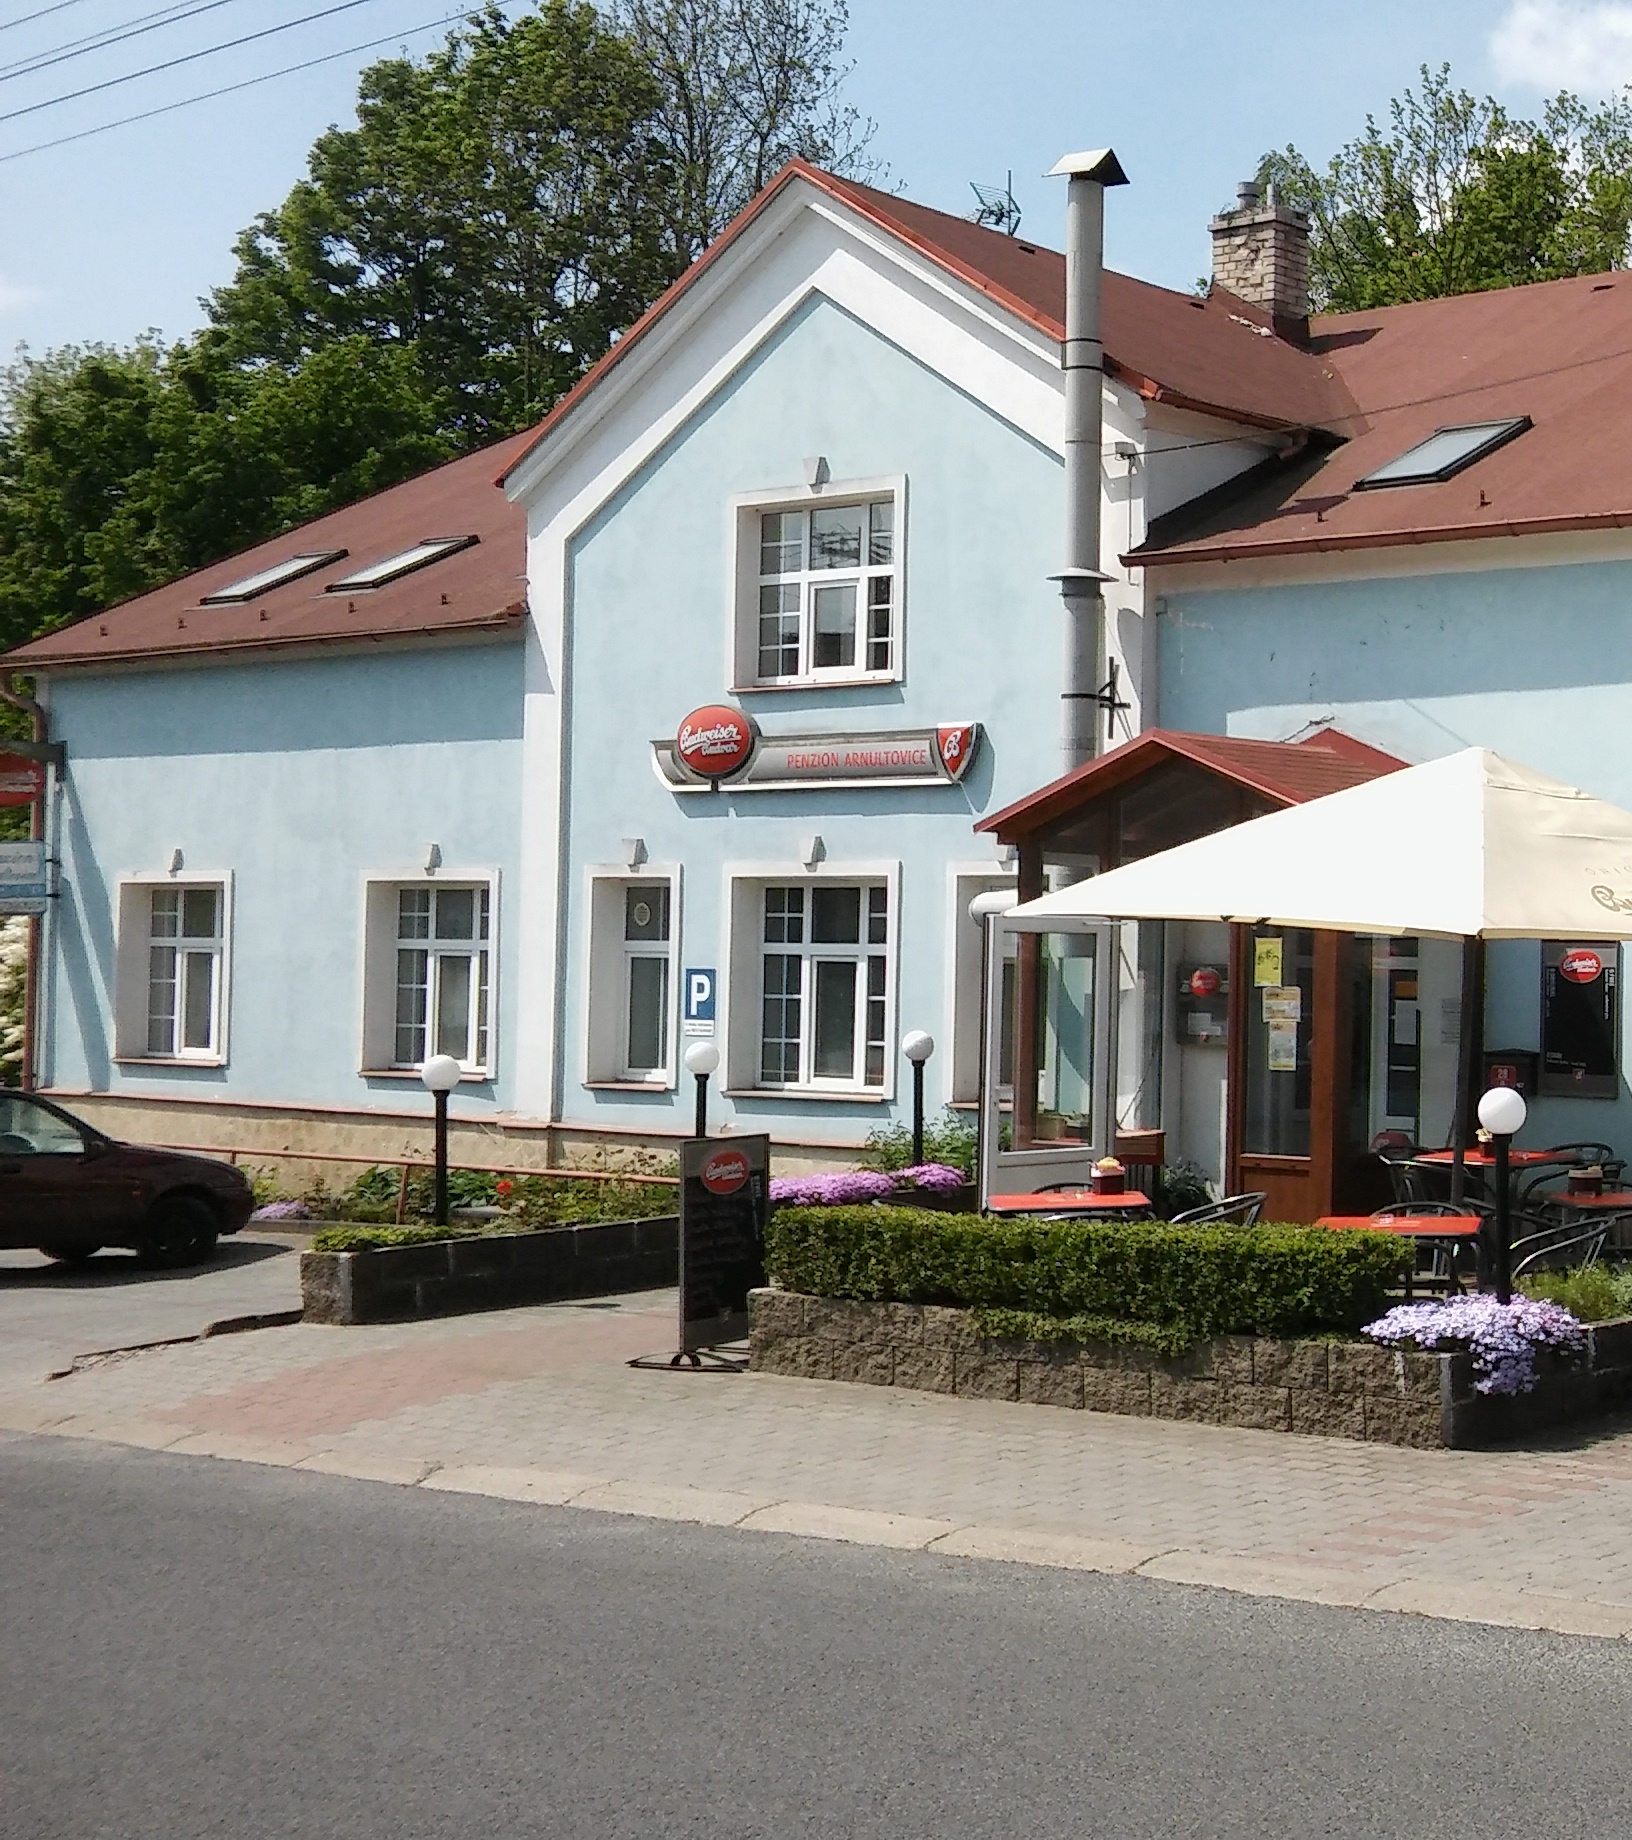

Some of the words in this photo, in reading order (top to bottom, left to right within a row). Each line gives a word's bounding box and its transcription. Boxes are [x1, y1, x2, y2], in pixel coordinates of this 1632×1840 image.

[680, 724, 742, 752] Budweiser
[787, 752, 839, 769] PENZION
[844, 749, 927, 767] ARNULTOVICE
[690, 974, 711, 1016] P
